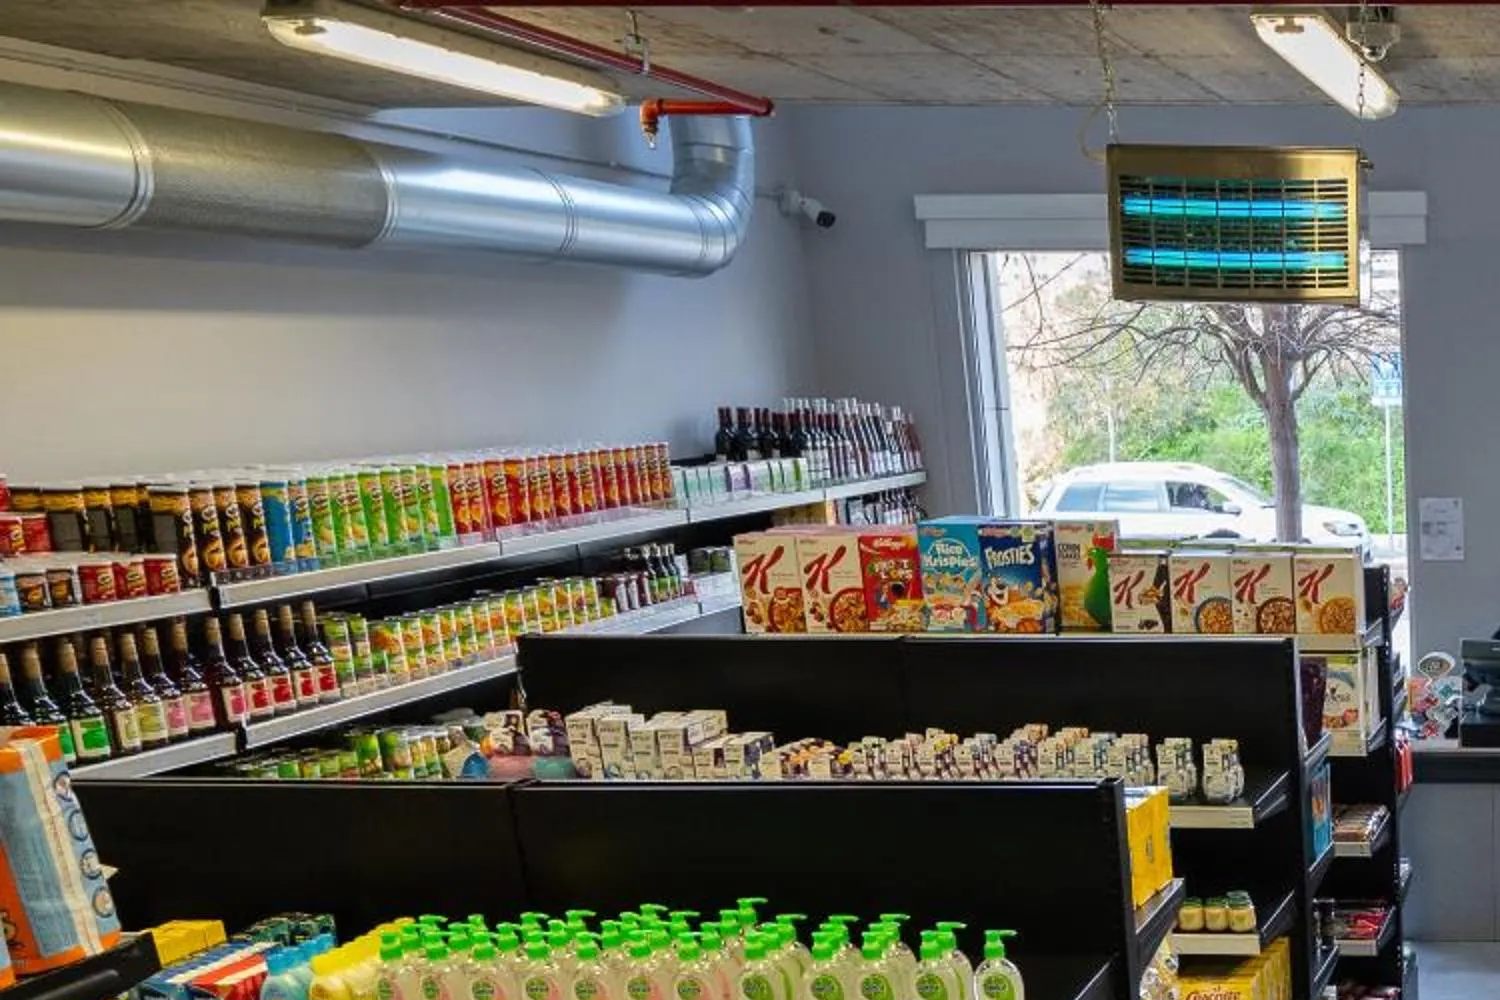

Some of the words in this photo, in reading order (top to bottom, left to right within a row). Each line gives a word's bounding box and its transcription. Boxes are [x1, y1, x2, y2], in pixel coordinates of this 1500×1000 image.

[935, 541, 963, 555] Rice
[984, 543, 1036, 569] FROSTIES
[742, 545, 785, 594] K
[803, 545, 847, 594] K
[1113, 570, 1145, 609] K
[1173, 562, 1210, 604] K
[1234, 563, 1271, 605] K
[1298, 563, 1335, 604] K
